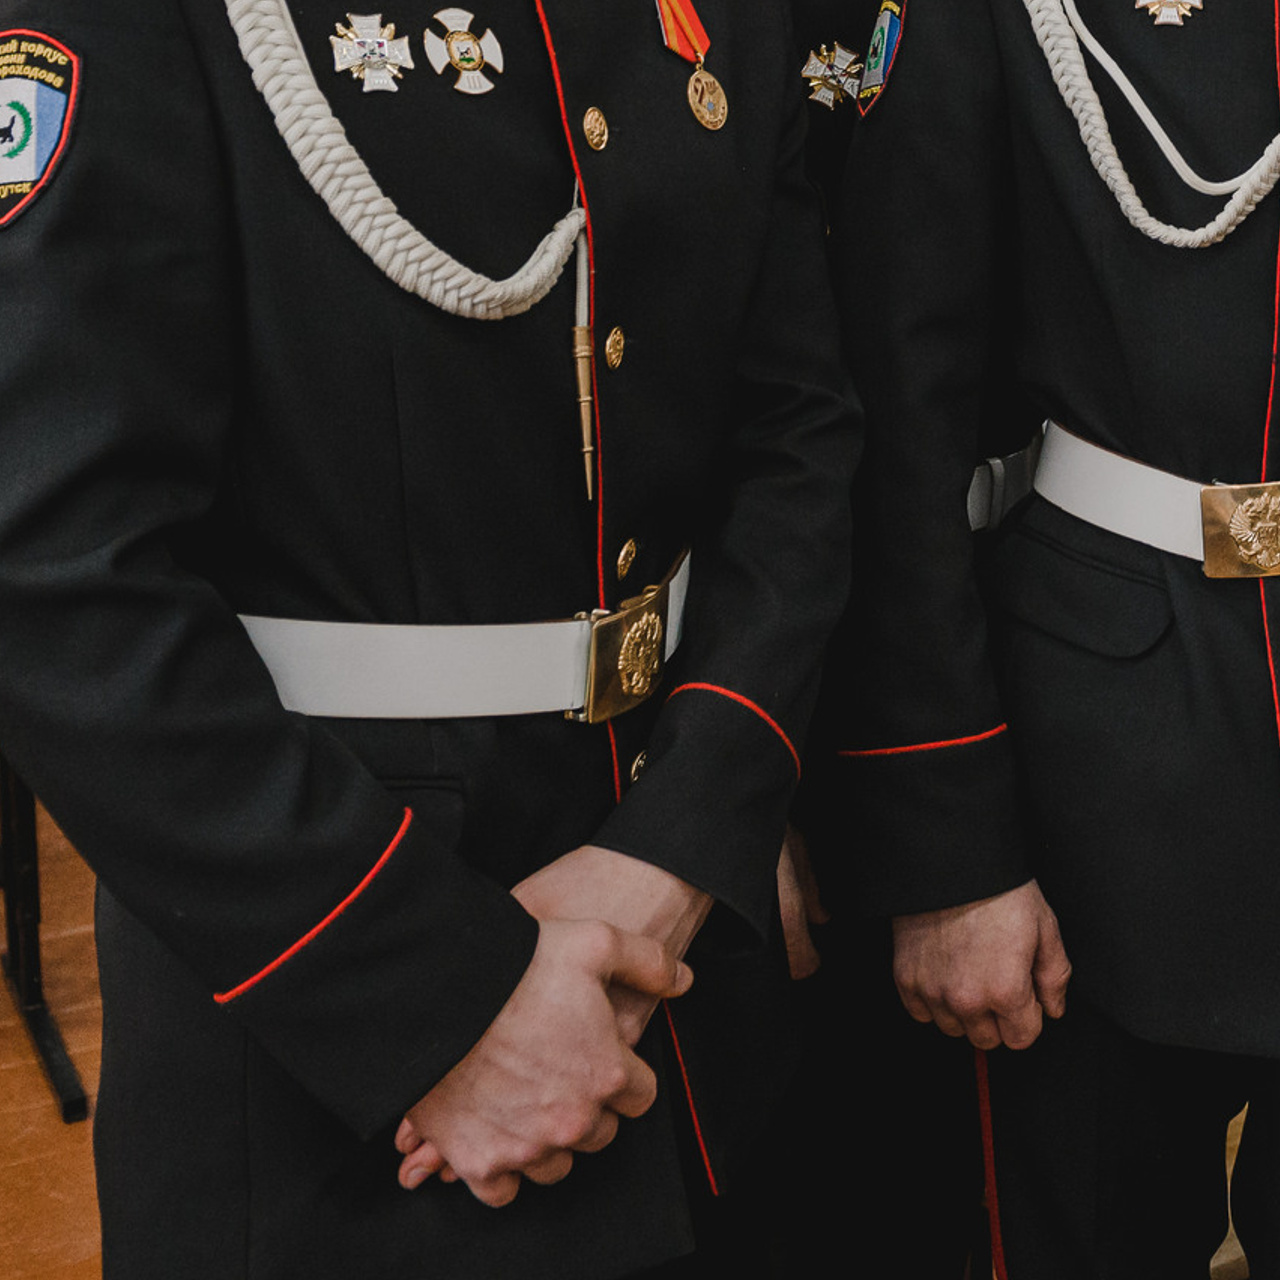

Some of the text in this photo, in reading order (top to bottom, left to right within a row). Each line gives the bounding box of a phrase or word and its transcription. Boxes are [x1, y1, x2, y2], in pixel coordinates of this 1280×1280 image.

[20, 40, 69, 66] корпус
[0, 64, 64, 89] роходова
[0, 181, 32, 199] утск
